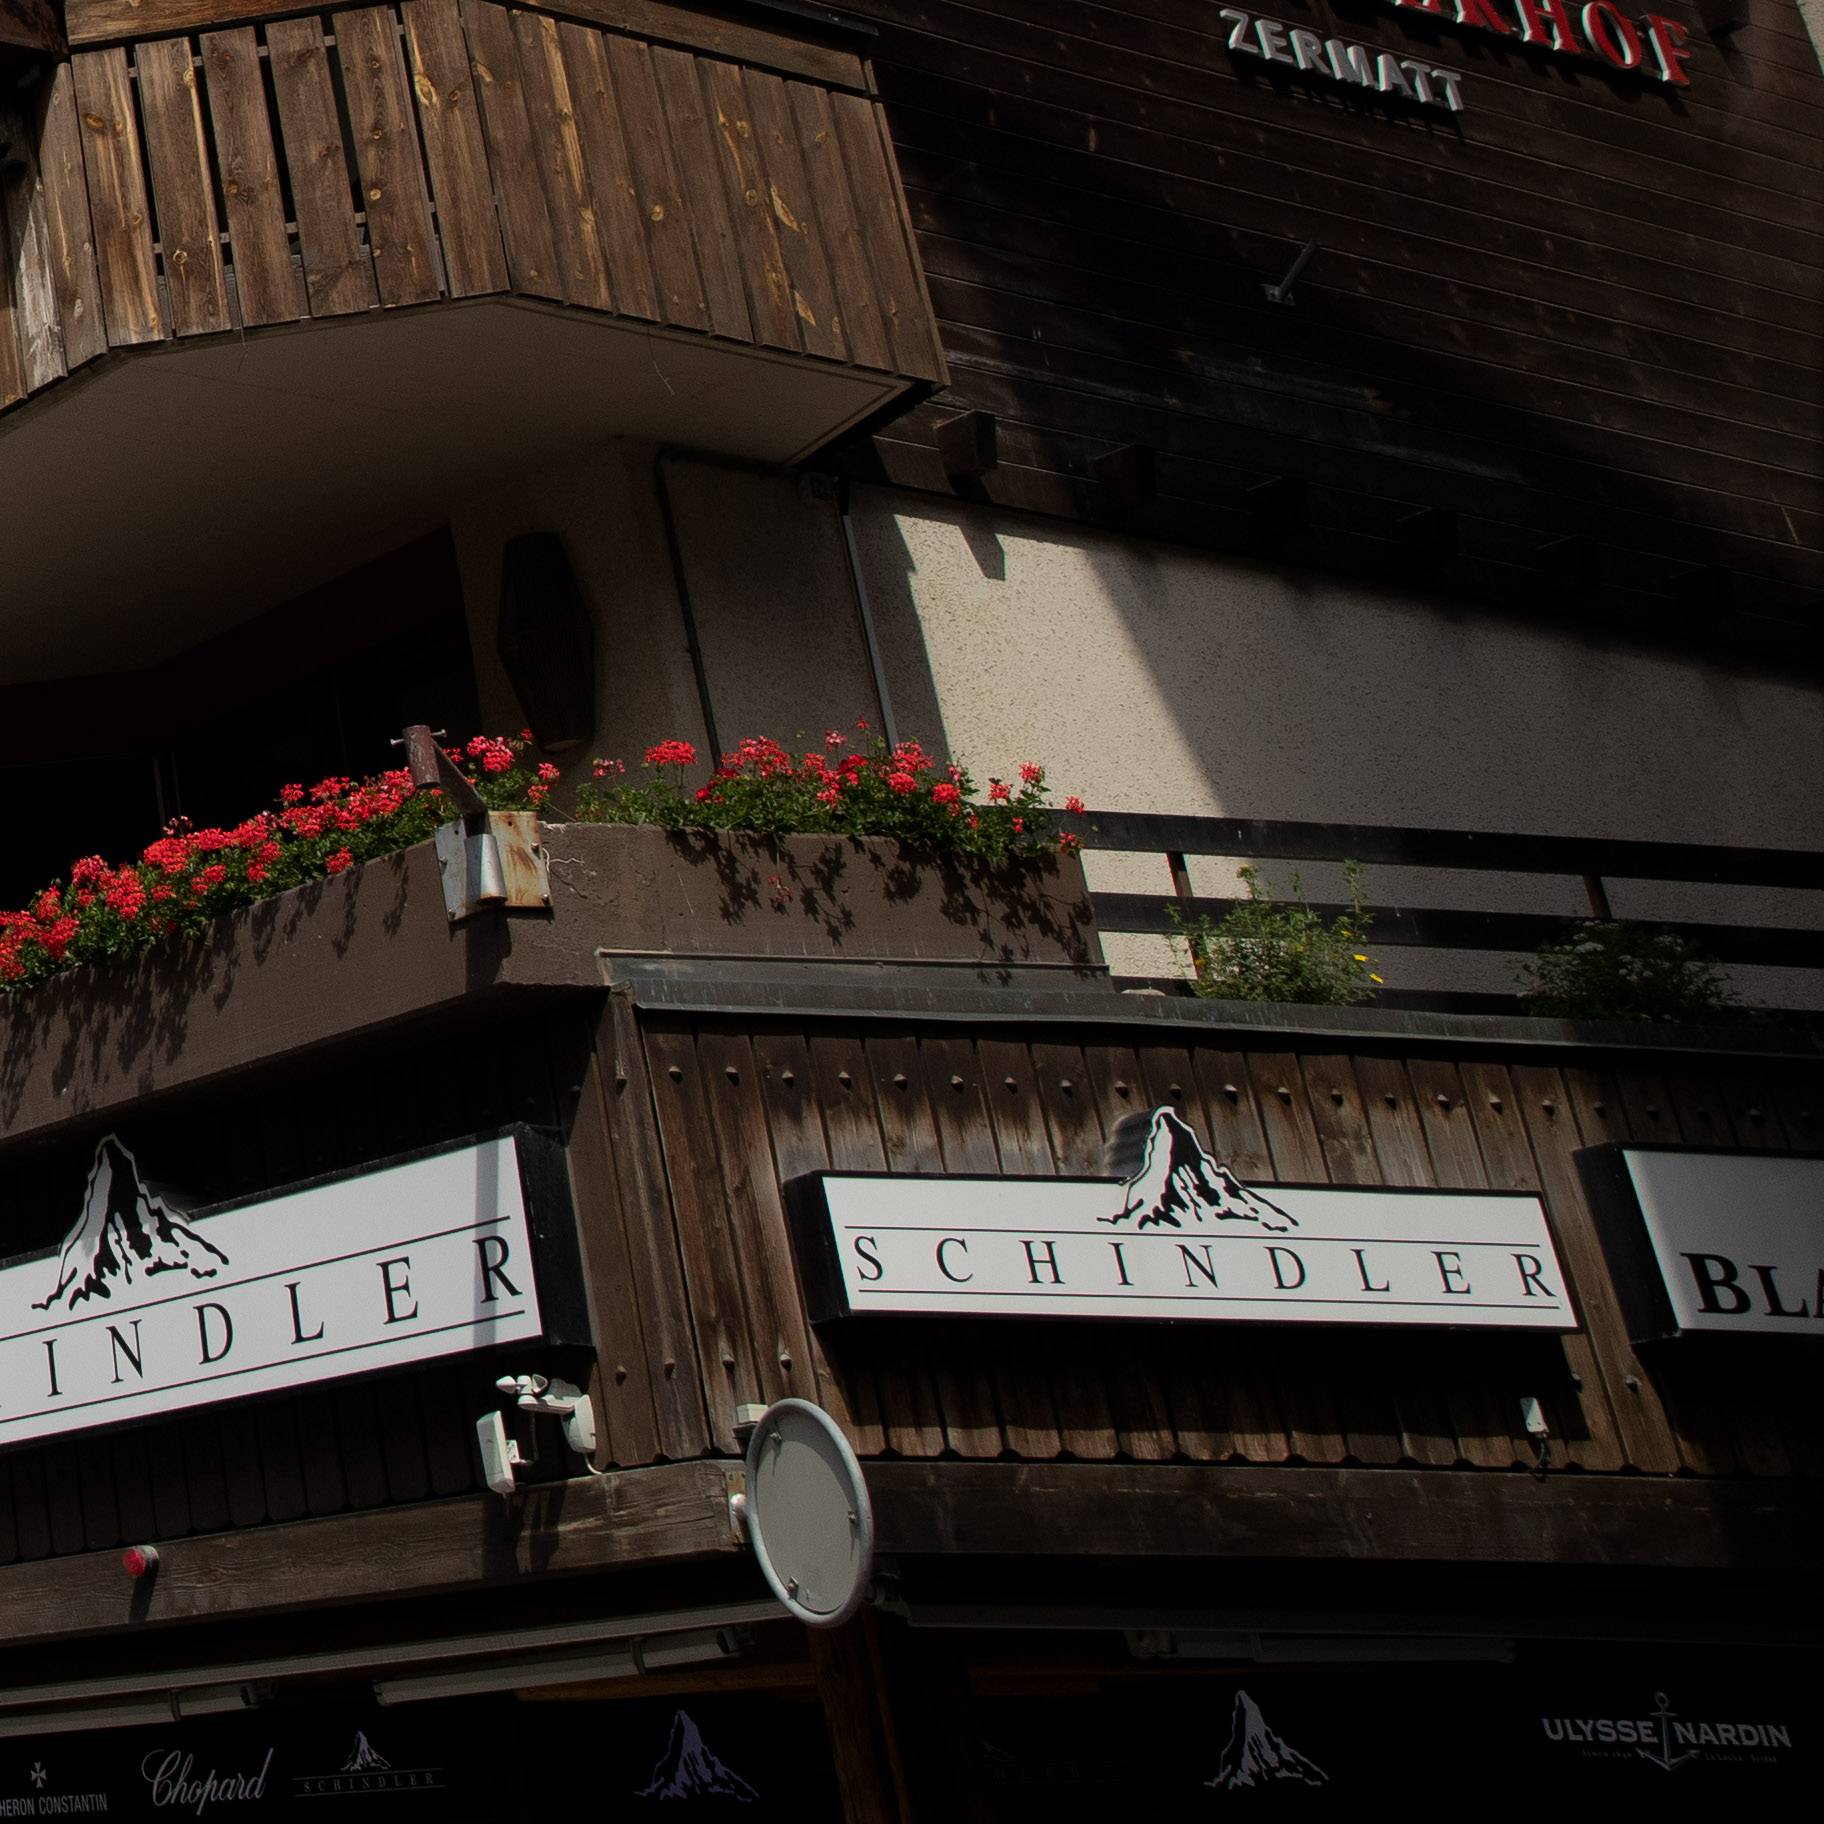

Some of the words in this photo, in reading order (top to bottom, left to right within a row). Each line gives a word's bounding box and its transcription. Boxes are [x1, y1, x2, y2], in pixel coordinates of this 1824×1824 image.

[1219, 9, 1464, 112] ZERMATT
[853, 1235, 1559, 1300] SCHINDLER
[1680, 1252, 1824, 1319] BL
[1541, 1717, 1660, 1744] ULYSSE
[1671, 1721, 1793, 1748] NARDIN
[38, 1793, 108, 1817] CONSTANTIN
[141, 1747, 274, 1816] Chopard
[303, 1772, 435, 1793] SCHINDLER
